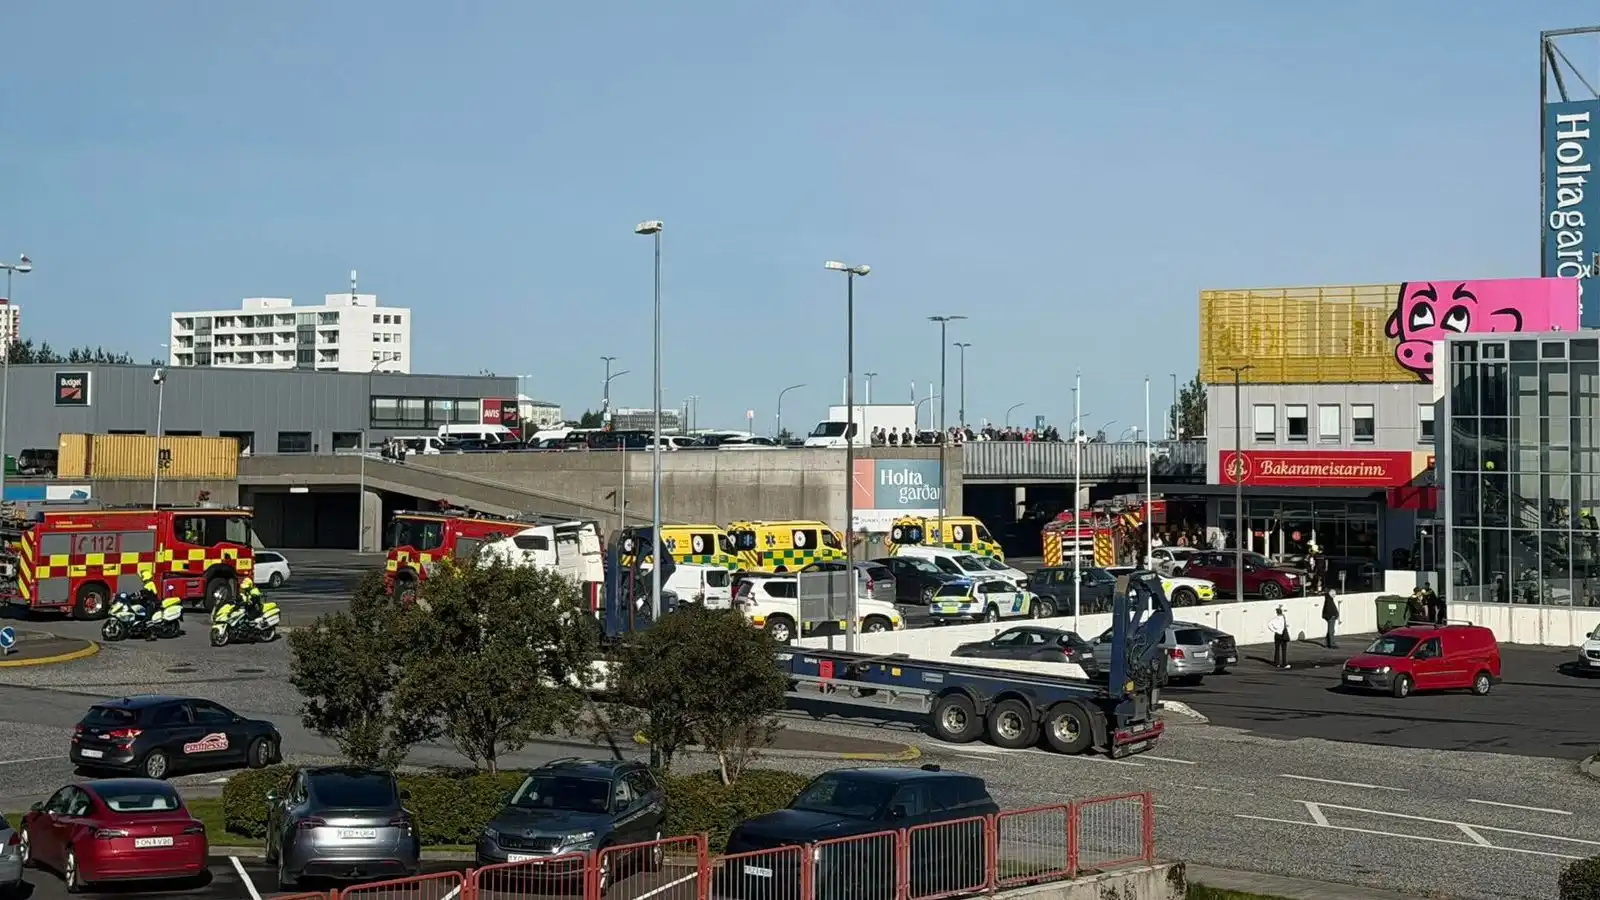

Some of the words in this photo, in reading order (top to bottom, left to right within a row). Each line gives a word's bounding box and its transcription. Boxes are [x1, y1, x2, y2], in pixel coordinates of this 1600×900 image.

[1550, 111, 1591, 315] Holtagarð
[484, 409, 500, 418] AVIS
[1260, 460, 1385, 476] Bakarameistarinn
[881, 469, 923, 485] Holta
[91, 536, 114, 550] 112
